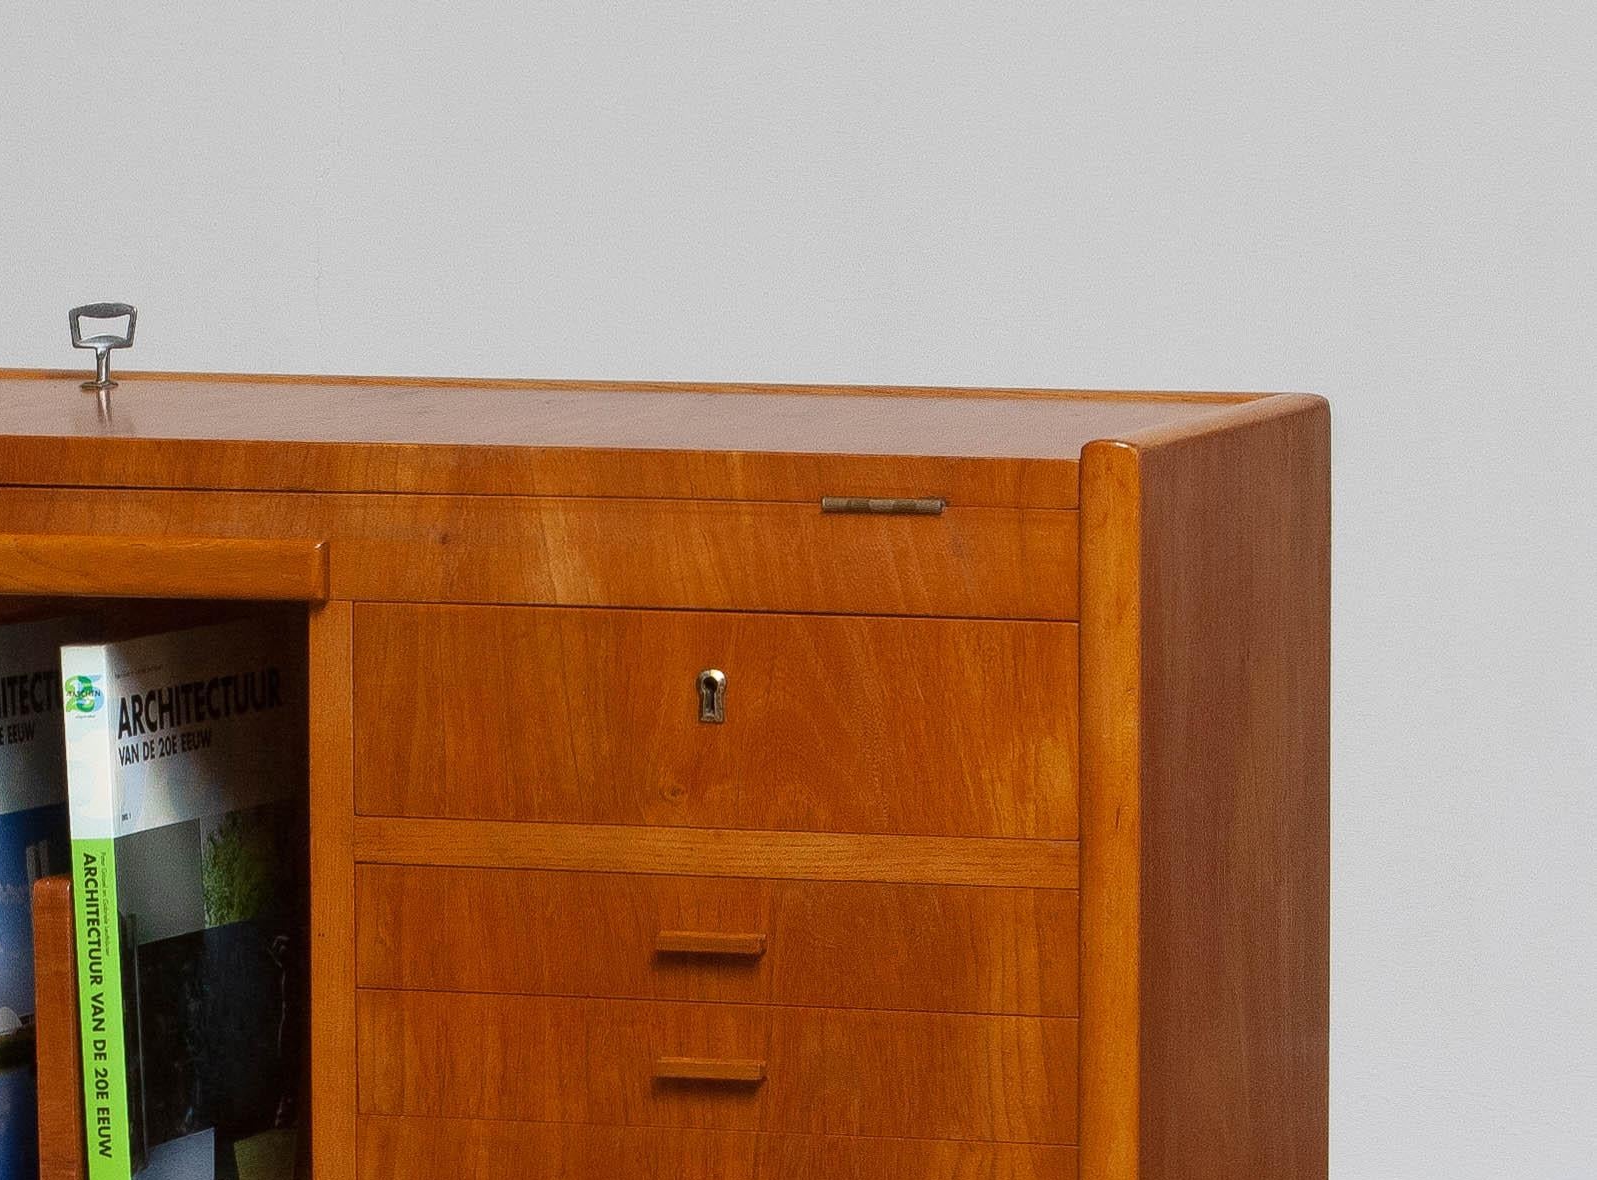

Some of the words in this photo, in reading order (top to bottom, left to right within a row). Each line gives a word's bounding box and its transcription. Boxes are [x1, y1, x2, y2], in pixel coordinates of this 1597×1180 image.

[118, 667, 283, 740] ARCHITECTUUR
[7, 720, 35, 745] EEUW
[118, 743, 140, 767] VAN
[143, 740, 155, 761] DE
[158, 736, 178, 758] 20E
[181, 729, 212, 753] EEUW
[83, 853, 103, 986] ARCHITECTUUR
[91, 992, 105, 1032] VAN
[93, 1039, 107, 1061] DE
[94, 1068, 109, 1100] 20E
[97, 1107, 112, 1158] EEUW
